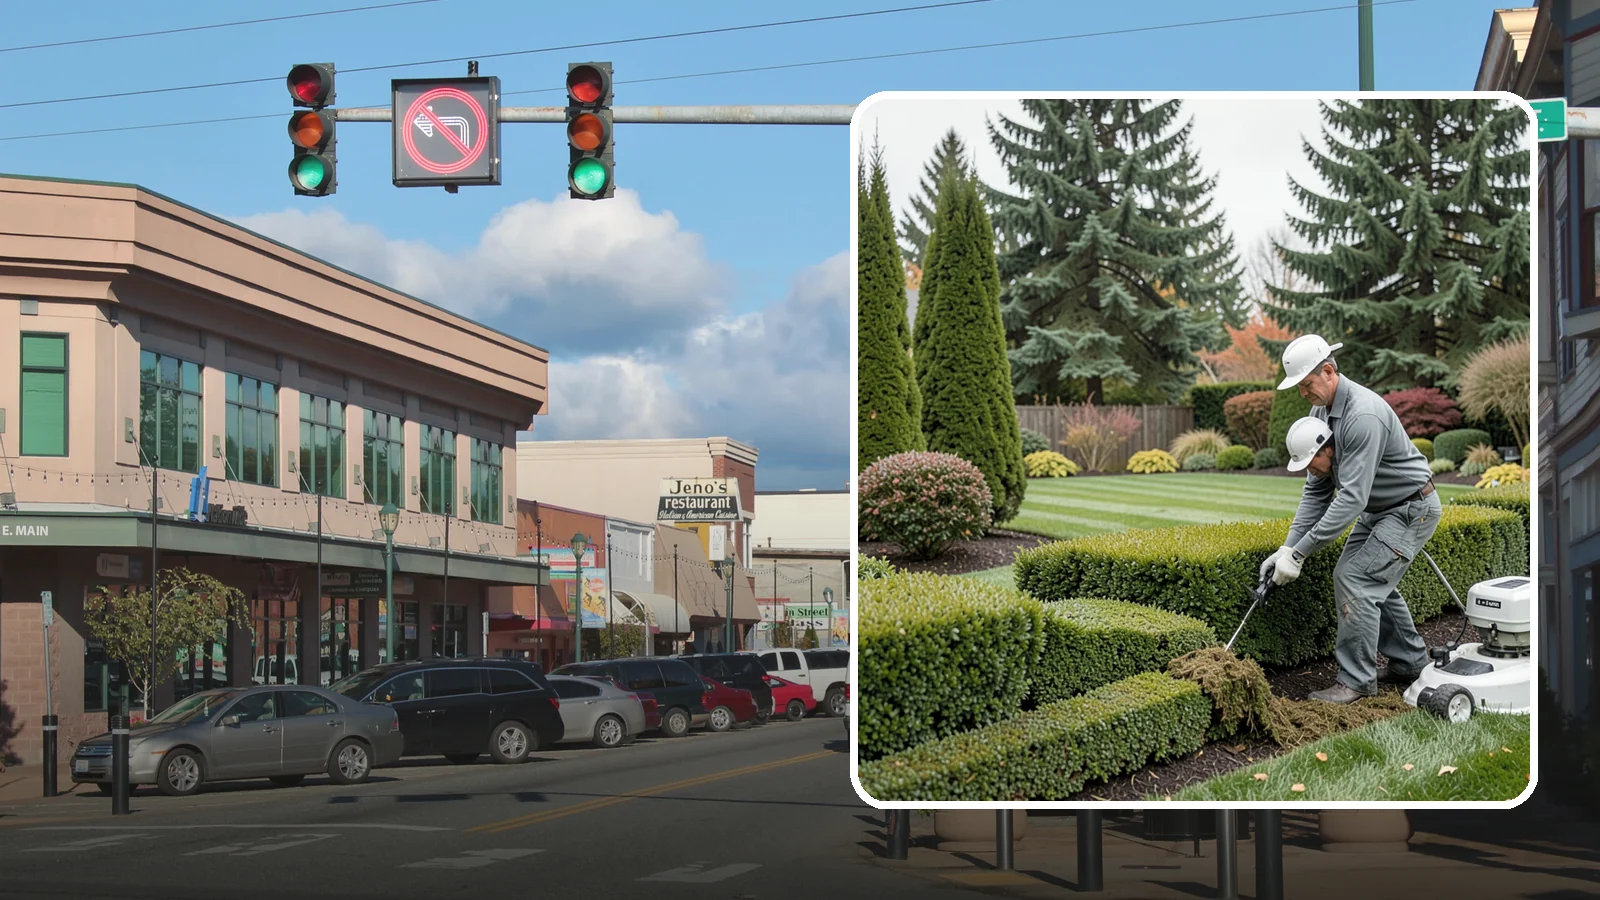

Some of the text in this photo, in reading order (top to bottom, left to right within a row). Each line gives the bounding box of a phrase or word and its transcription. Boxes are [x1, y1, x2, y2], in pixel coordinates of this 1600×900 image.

[670, 480, 727, 494] Jeno's
[665, 496, 731, 509] restaurant
[658, 509, 681, 519] Italian
[686, 509, 714, 519] American
[715, 509, 737, 519] Cuisine
[2, 525, 49, 536] E. MAIN
[797, 608, 828, 616] Street
